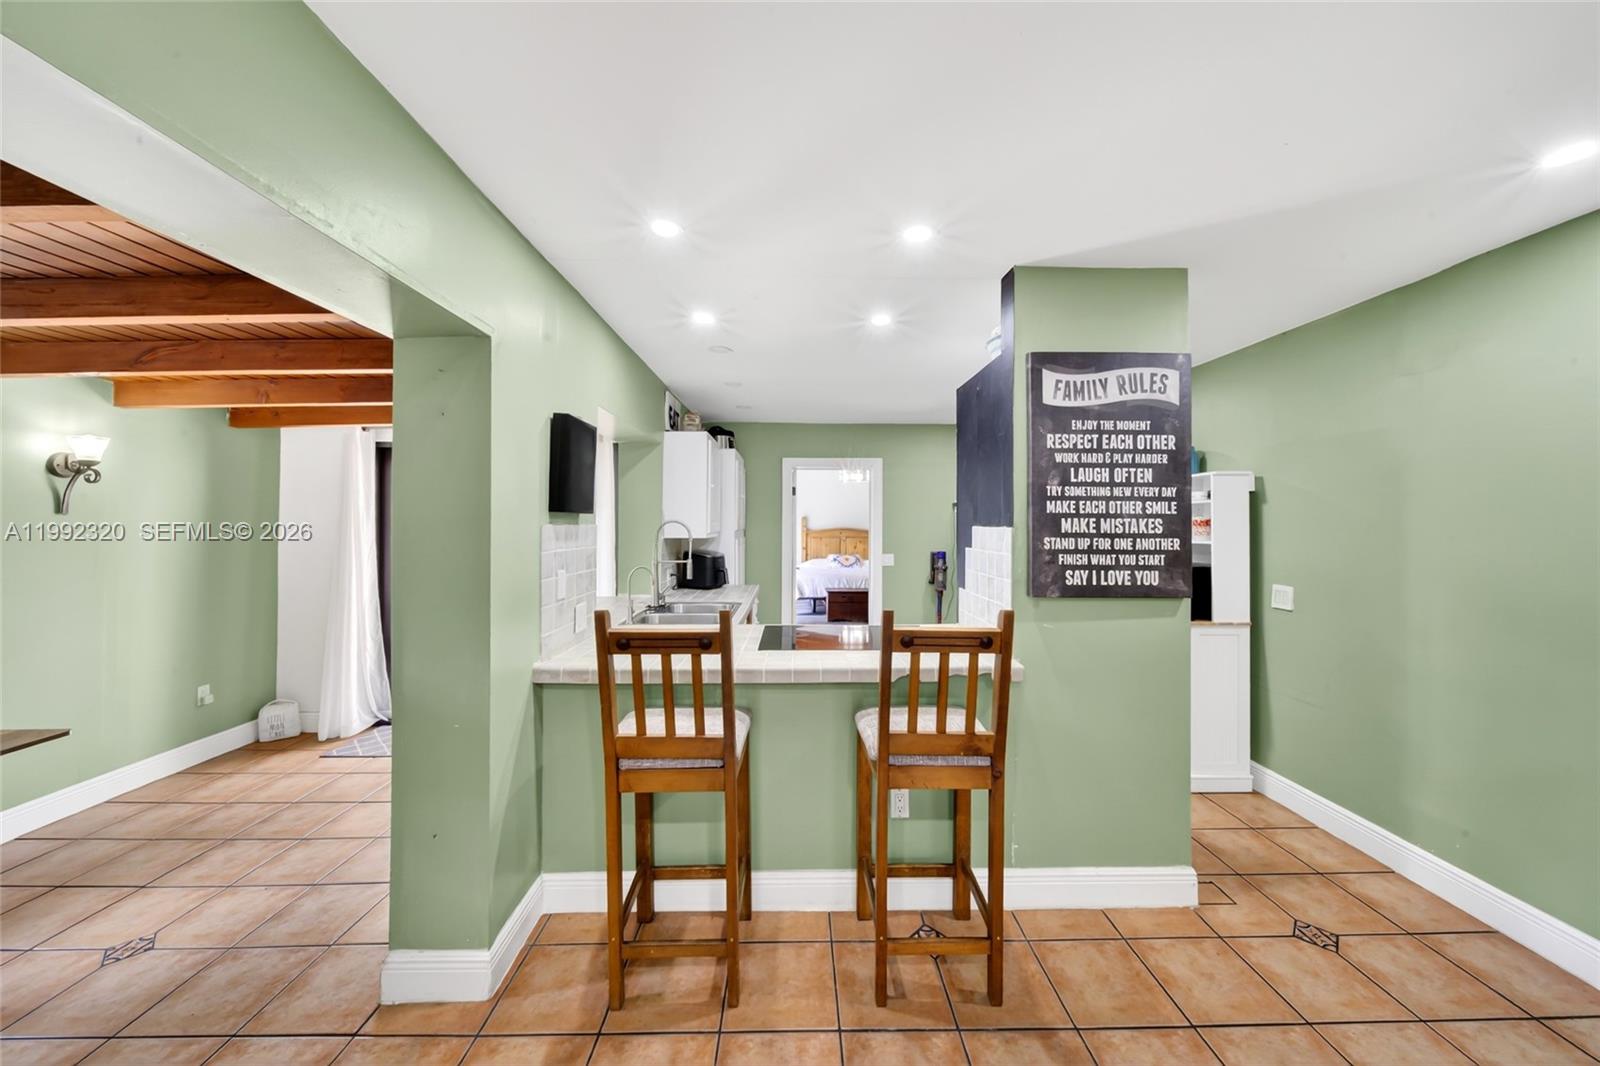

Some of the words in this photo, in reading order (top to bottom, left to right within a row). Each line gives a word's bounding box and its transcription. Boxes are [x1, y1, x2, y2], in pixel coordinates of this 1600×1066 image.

[1052, 377, 1108, 402] FAMILY
[1116, 372, 1169, 396] RULES
[1071, 420, 1098, 431] ENJOY
[1100, 420, 1115, 431] THE
[1116, 420, 1151, 431] MOMENT
[1046, 434, 1098, 449] RESPECT
[1102, 434, 1133, 449] EACH
[1137, 434, 1176, 450] OTHER
[1054, 452, 1079, 464] WORK
[1081, 452, 1104, 464] HARD
[1113, 453, 1133, 464] PLAY
[1135, 453, 1168, 464] HARDER
[1070, 467, 1110, 483] LAUGH
[1113, 467, 1153, 483] OFTEN
[1046, 486, 1062, 496] TRY
[1064, 486, 1111, 497] SOMETHING
[1113, 487, 1132, 497] NEW
[1134, 487, 1160, 497] EVERY
[1161, 487, 1177, 497] DAY
[1046, 500, 1076, 514] MAKE
[1079, 501, 1106, 514] EACH
[1108, 501, 1143, 514] OTHER
[1145, 501, 1177, 514] SMILE
[1061, 518, 1097, 534] MAKE
[1100, 518, 1164, 534] MISTAKES
[1043, 537, 1075, 550] STAND
[1077, 537, 1091, 550] UP
[1092, 538, 1111, 550] FOR
[1113, 538, 1133, 550] ONE
[1135, 538, 1180, 551] ANOTHER
[1058, 554, 1088, 566] FINISH
[1090, 554, 1117, 566] WHAT
[1118, 554, 1136, 566] YOU
[1138, 554, 1166, 566] START
[1065, 570, 1089, 586] SAY
[1092, 570, 1097, 586] I
[1100, 570, 1132, 586] LOVE
[1134, 570, 1160, 586] YOU
